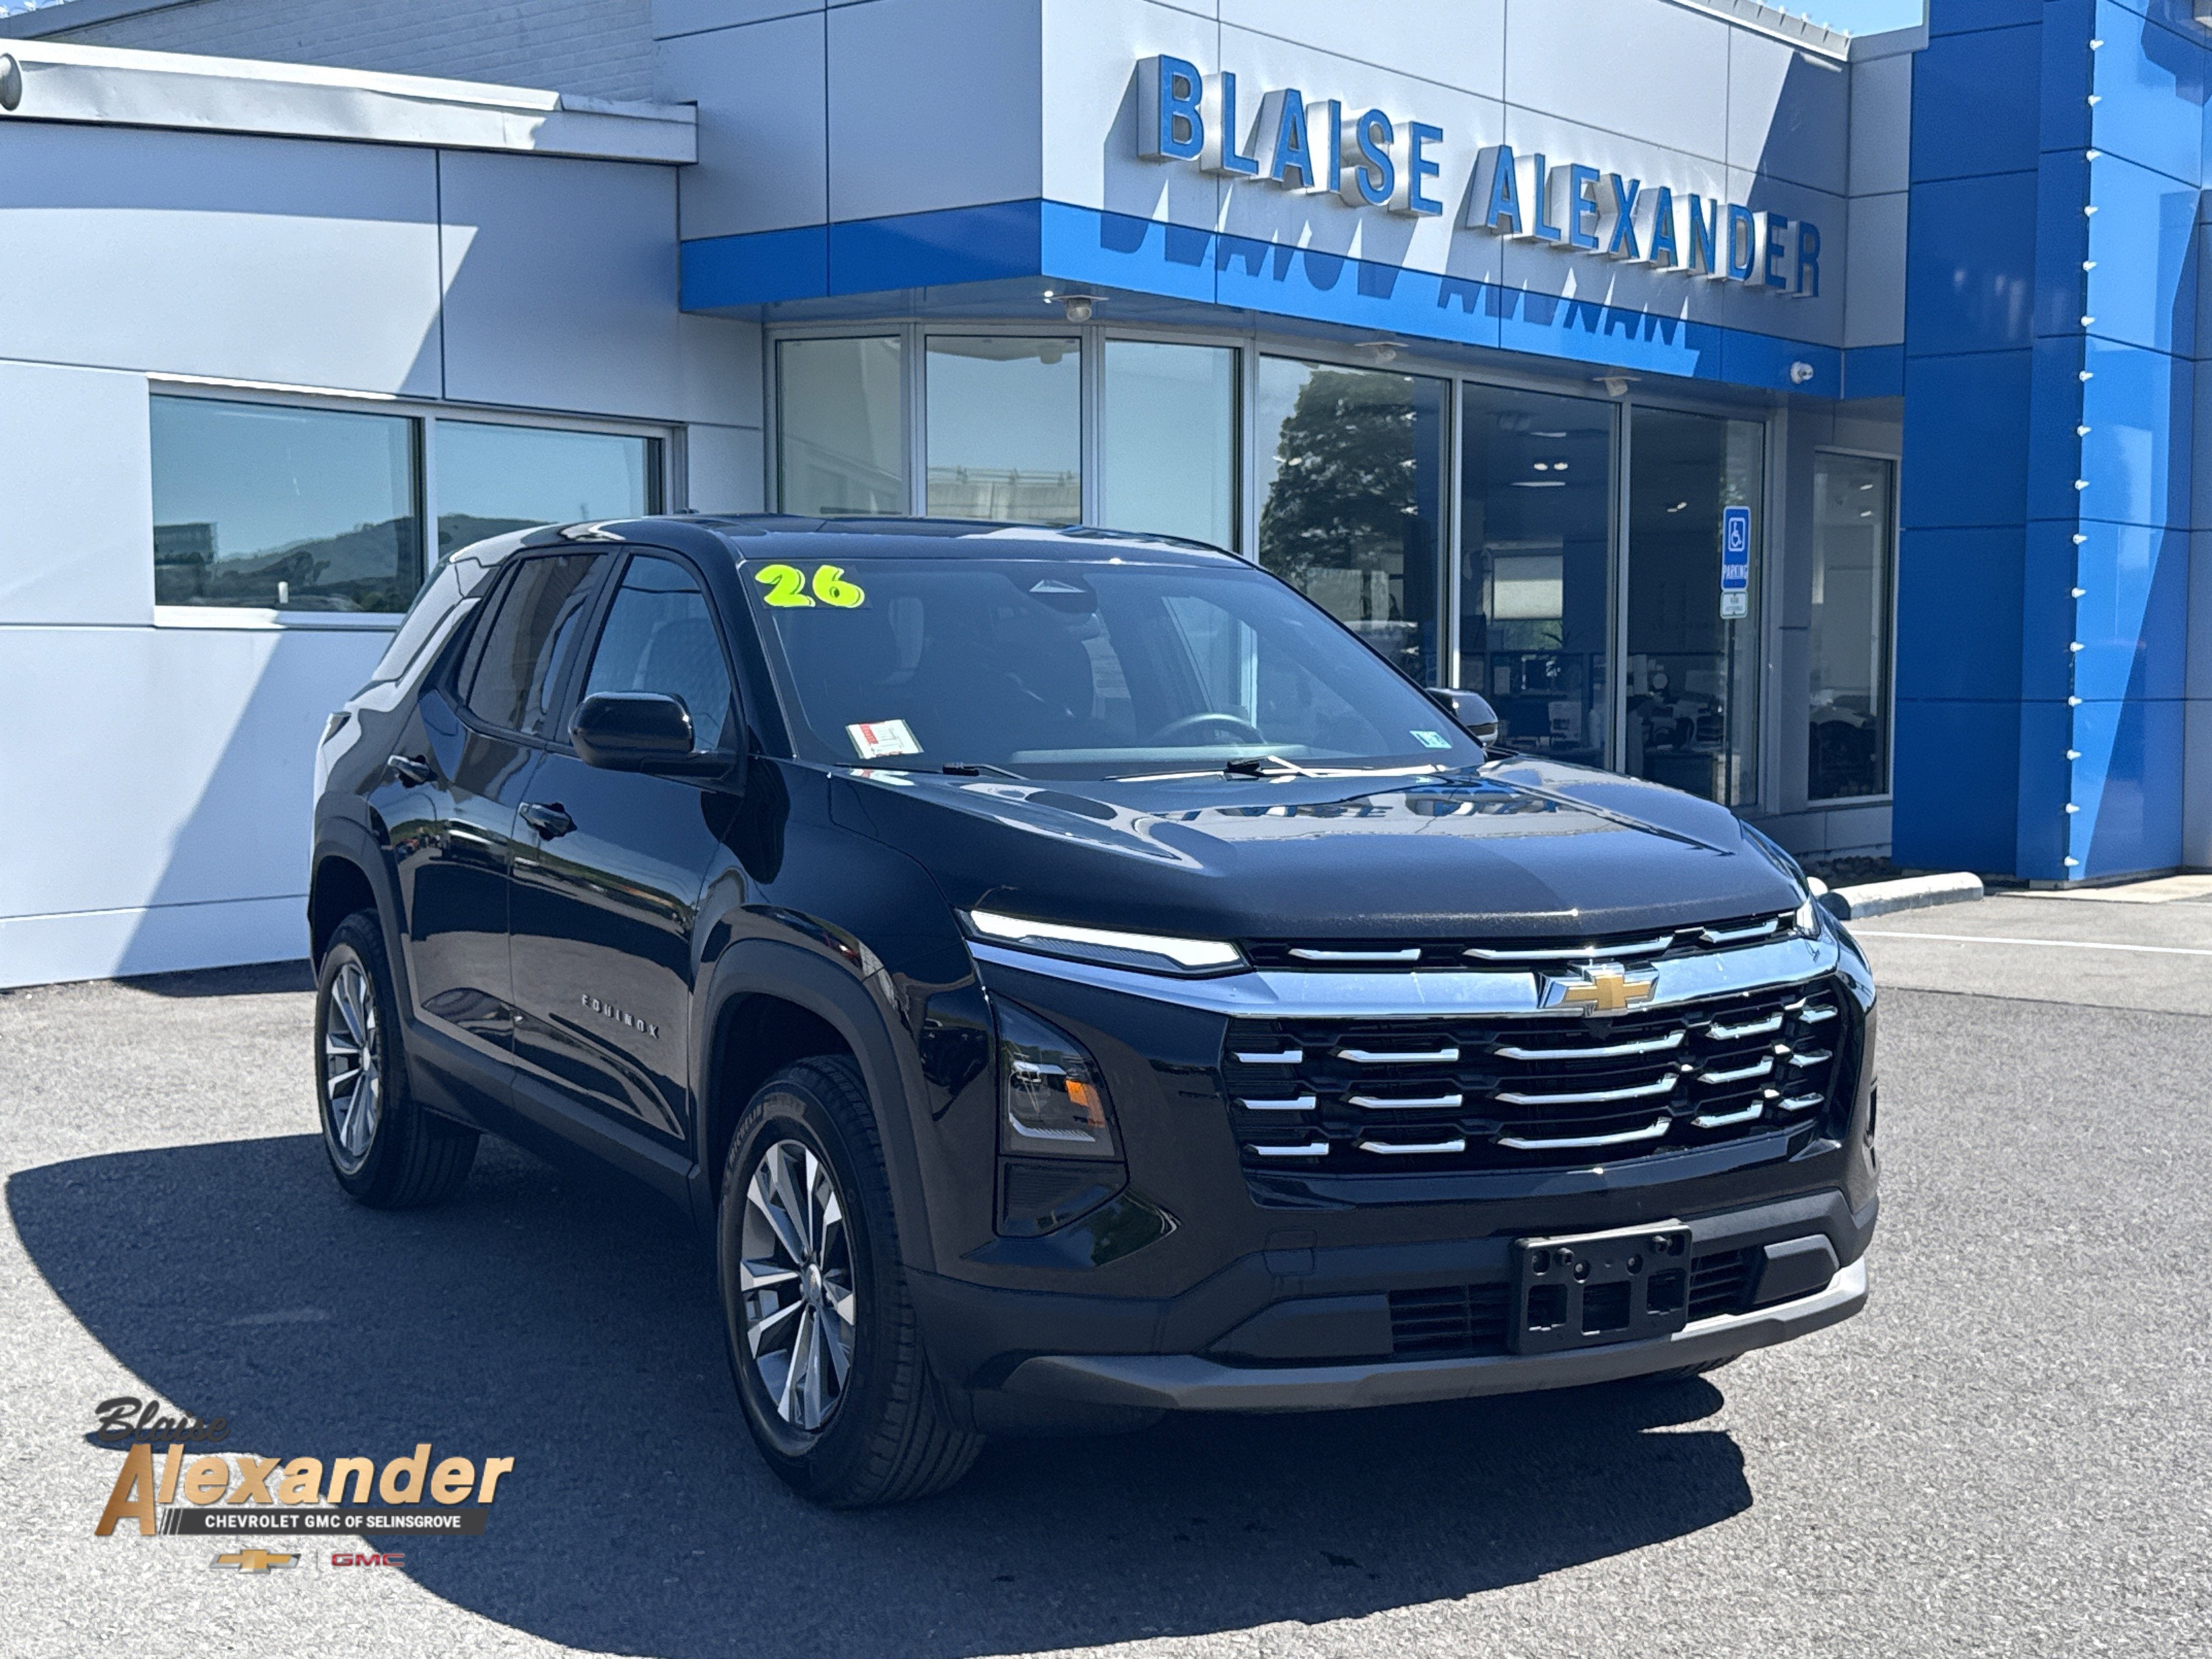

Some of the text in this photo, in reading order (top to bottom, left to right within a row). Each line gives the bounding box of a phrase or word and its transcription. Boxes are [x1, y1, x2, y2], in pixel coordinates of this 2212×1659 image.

[1155, 54, 1821, 297] BLAISE ALEXANDER
[755, 564, 865, 608] 26
[581, 993, 659, 1039] EQUINOX
